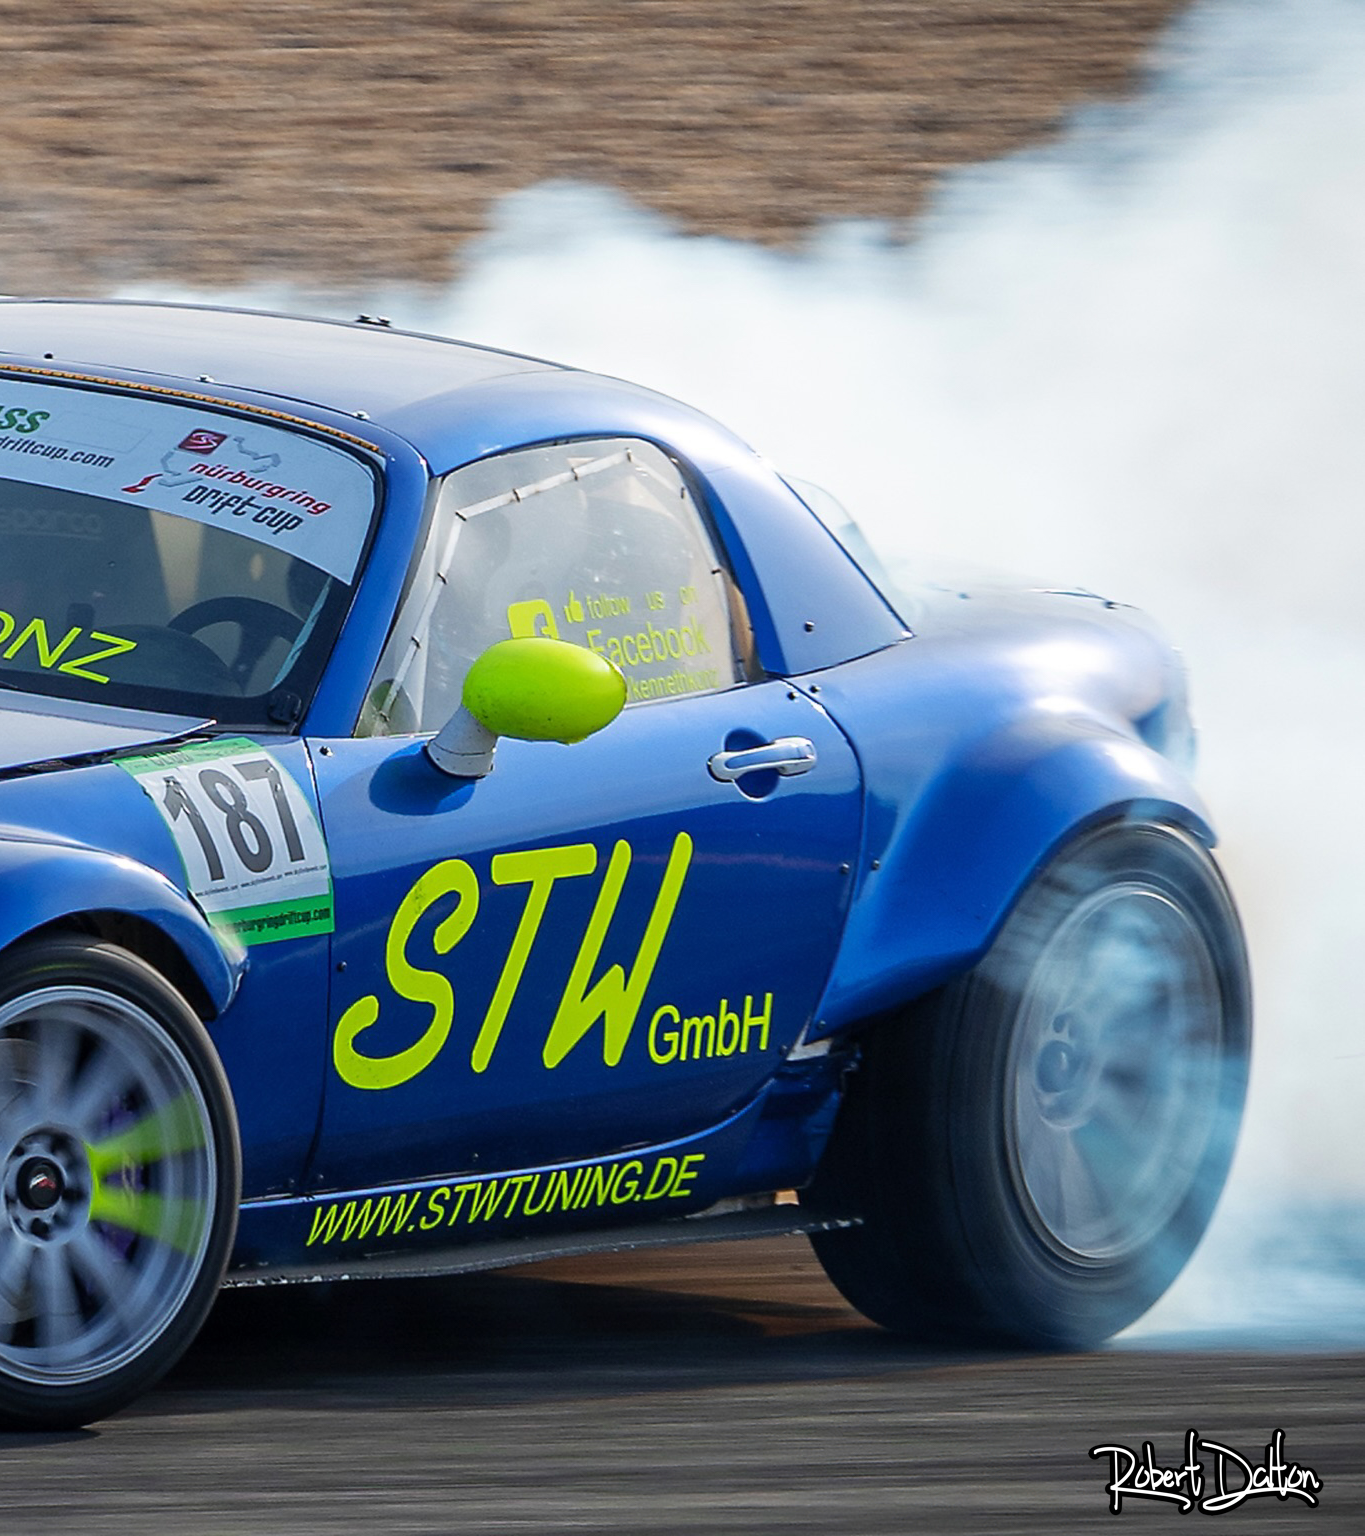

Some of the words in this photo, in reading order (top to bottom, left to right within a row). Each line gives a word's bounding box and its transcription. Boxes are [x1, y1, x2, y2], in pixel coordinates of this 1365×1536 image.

[188, 463, 332, 515] nürburgring
[586, 592, 631, 619] follow
[645, 590, 666, 611] us
[586, 616, 712, 668] Facebook
[163, 758, 306, 882] 187
[334, 831, 693, 1090] STW
[648, 992, 774, 1065] GmbH
[306, 1153, 706, 1247] WWW.STWTUNING.DE
